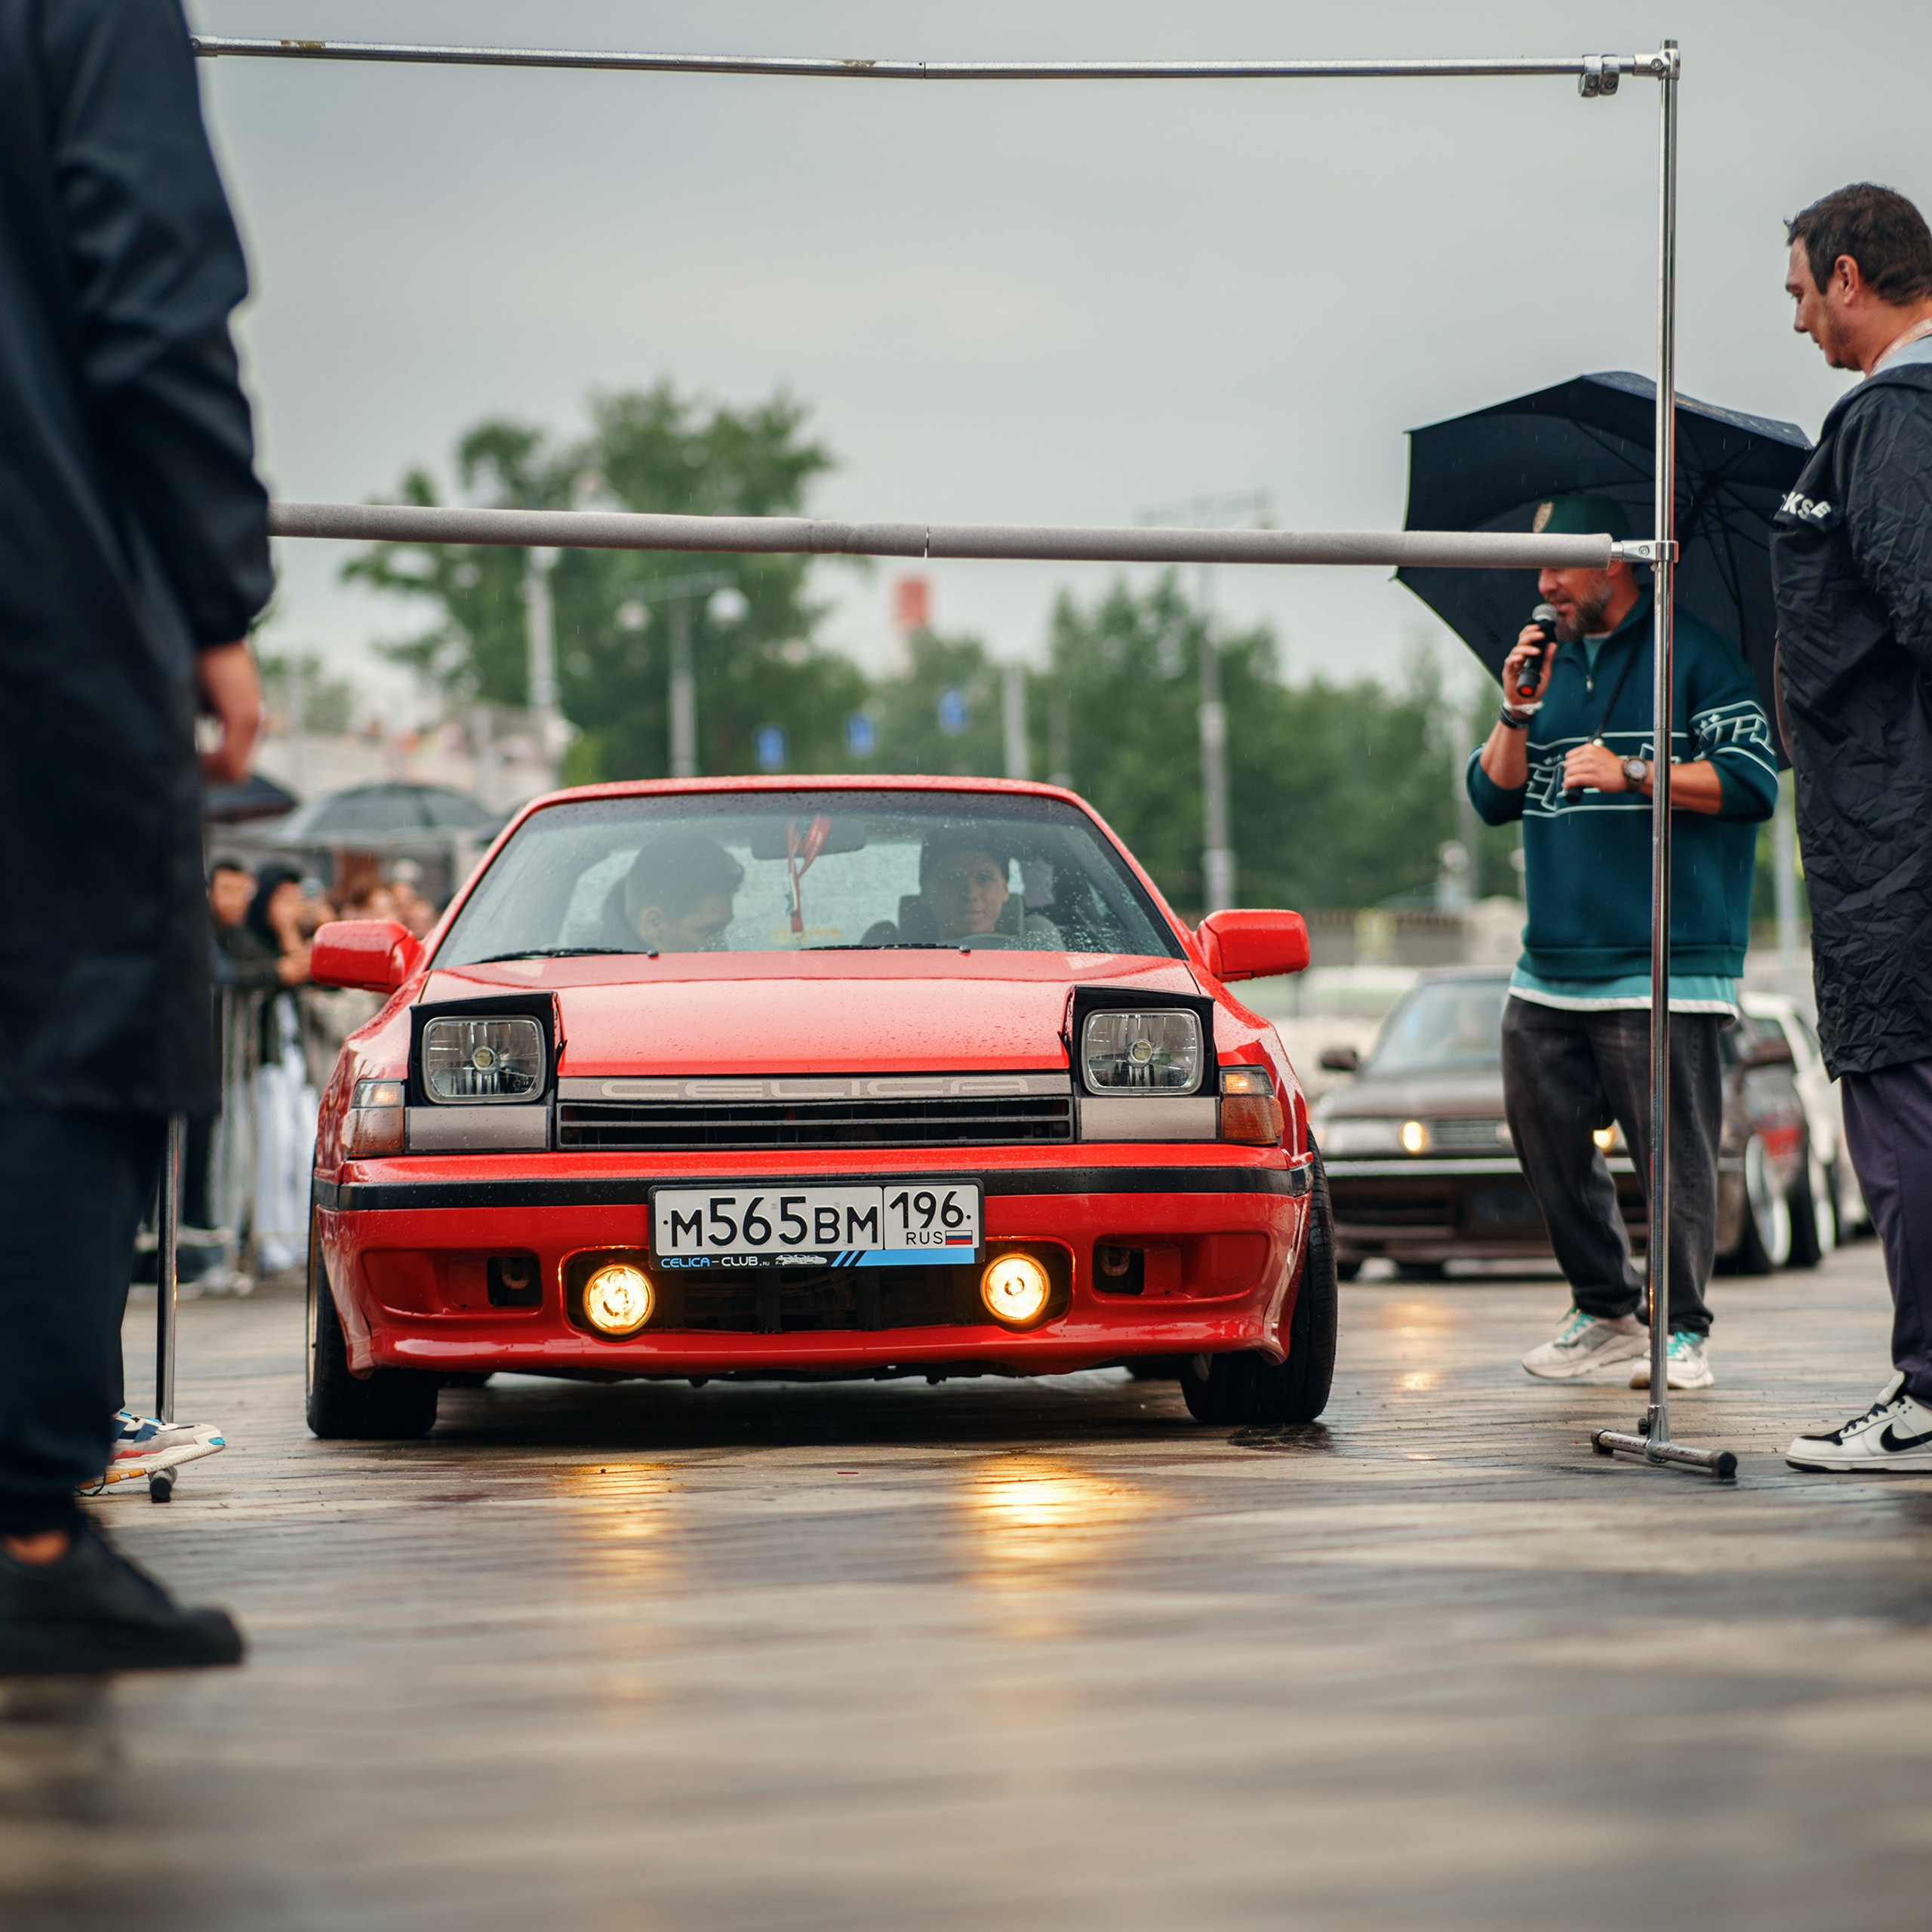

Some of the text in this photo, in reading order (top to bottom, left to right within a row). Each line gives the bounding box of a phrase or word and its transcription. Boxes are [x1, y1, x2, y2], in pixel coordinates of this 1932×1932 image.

[601, 1077, 1029, 1098] CELICA
[890, 1191, 964, 1229] 196
[906, 1231, 943, 1245] RUS
